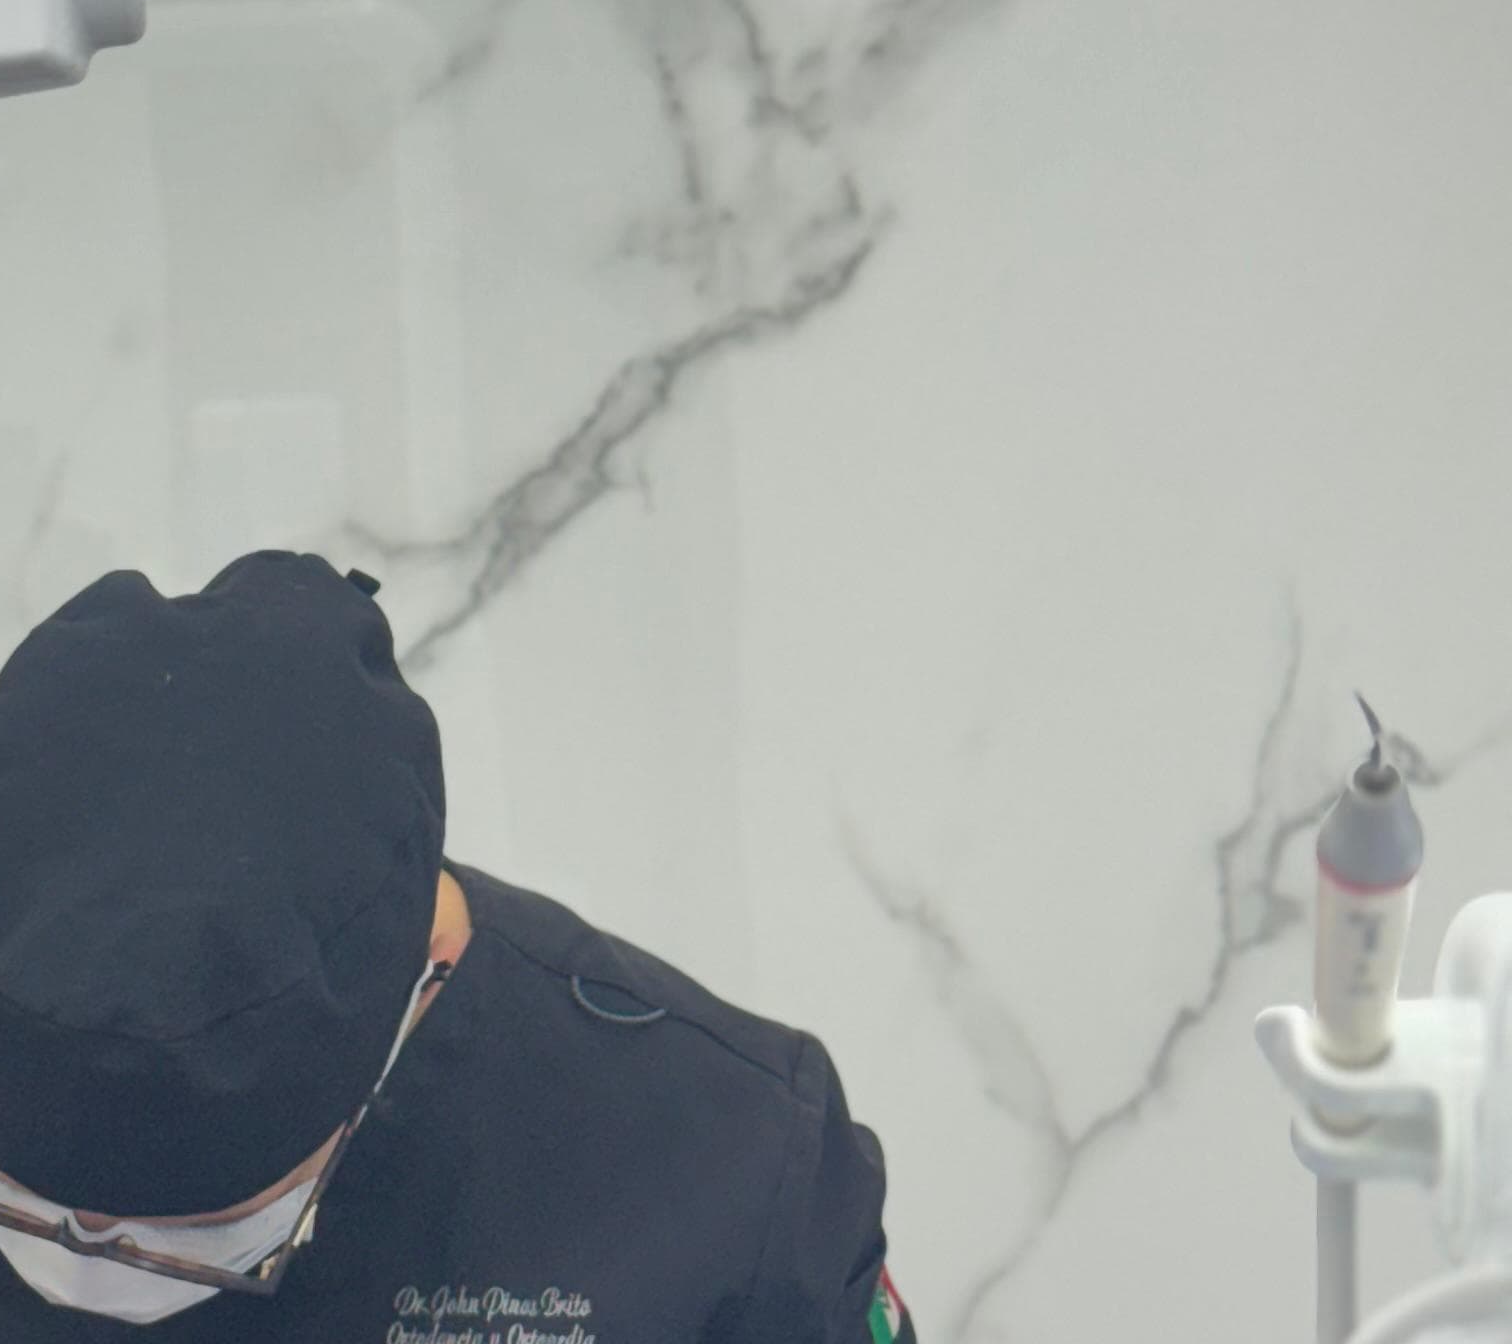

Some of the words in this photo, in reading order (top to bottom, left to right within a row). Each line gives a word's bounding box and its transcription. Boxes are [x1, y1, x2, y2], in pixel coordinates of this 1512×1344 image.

[430, 1284, 480, 1320] John
[482, 1286, 538, 1323] Pinos
[540, 1286, 592, 1318] Brito
